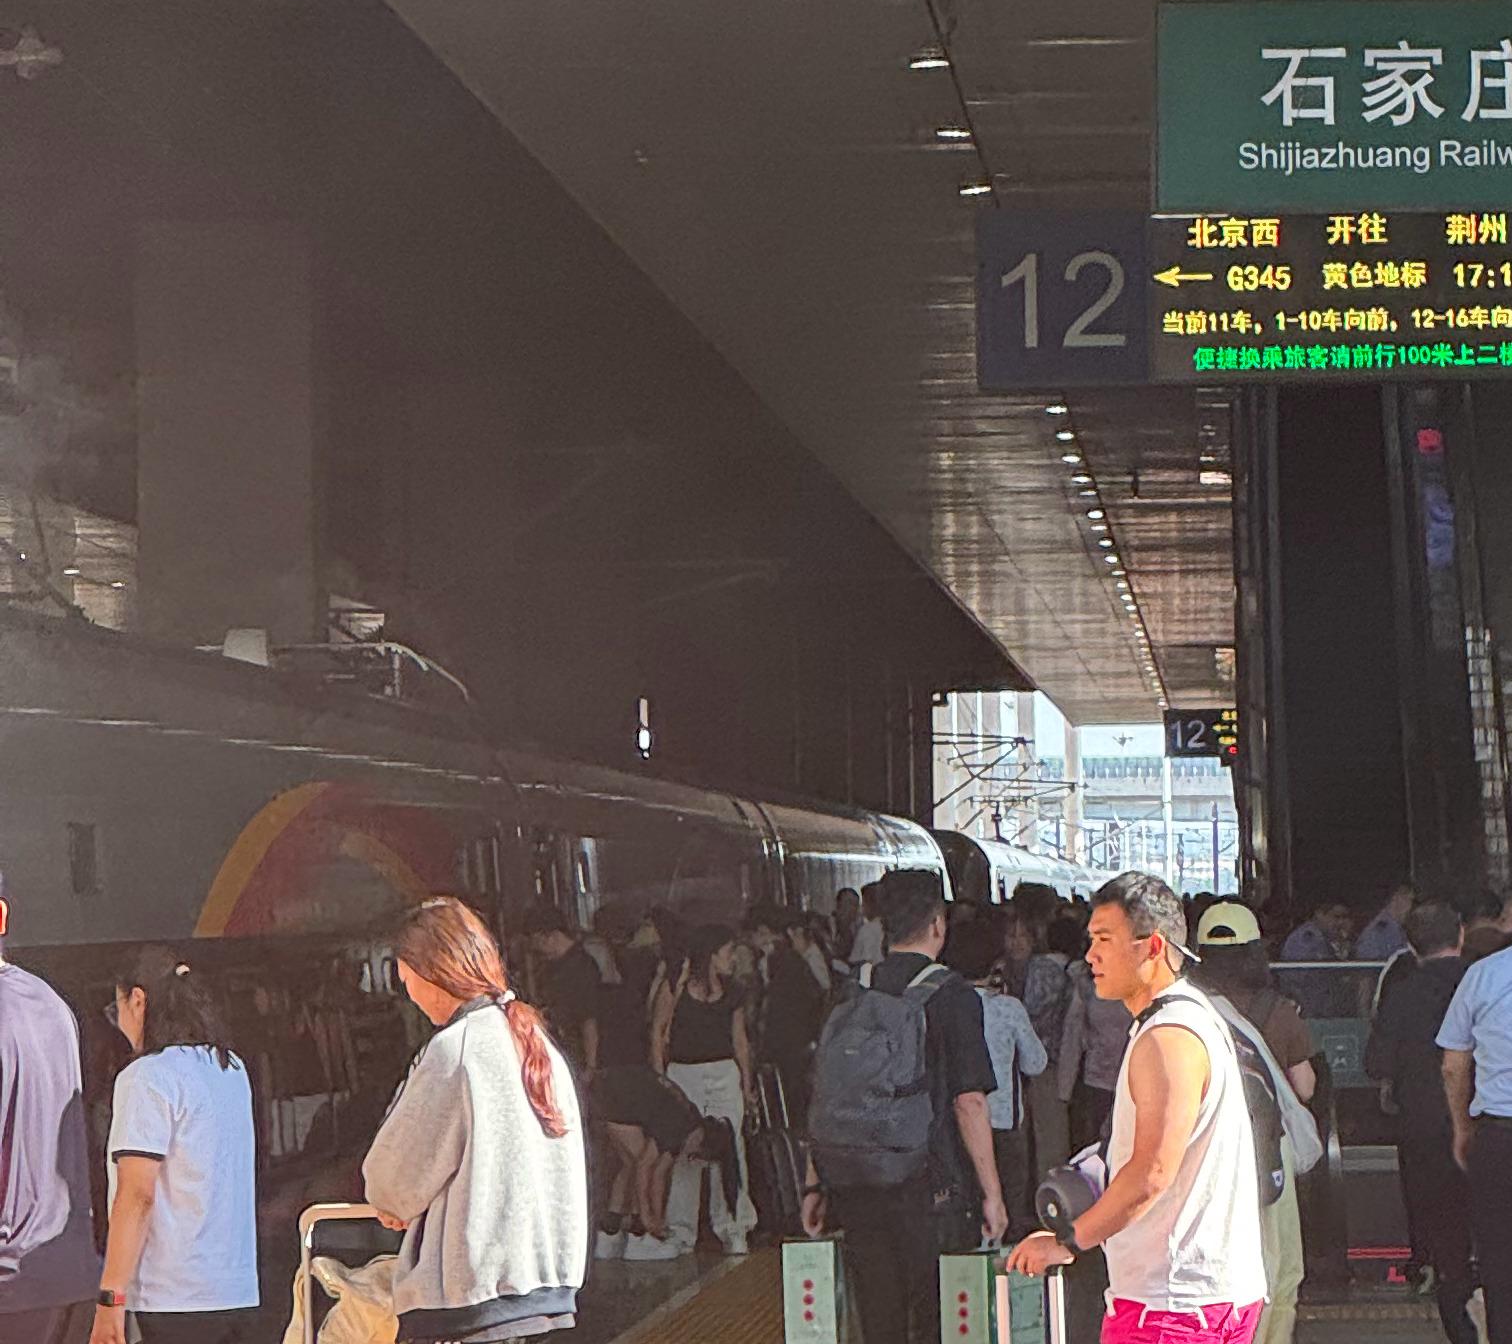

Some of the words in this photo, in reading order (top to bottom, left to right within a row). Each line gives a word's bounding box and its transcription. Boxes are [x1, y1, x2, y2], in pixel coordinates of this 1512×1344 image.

[1239, 142, 1429, 175] Shijiazhuang
[1187, 217, 1281, 248] 北京西
[1326, 212, 1389, 245] 开往
[1445, 214, 1507, 245] 荆州
[1226, 265, 1292, 292] G345
[1321, 261, 1427, 290] 黄色地标
[1001, 252, 1126, 349] 12
[1170, 719, 1206, 749] 12
